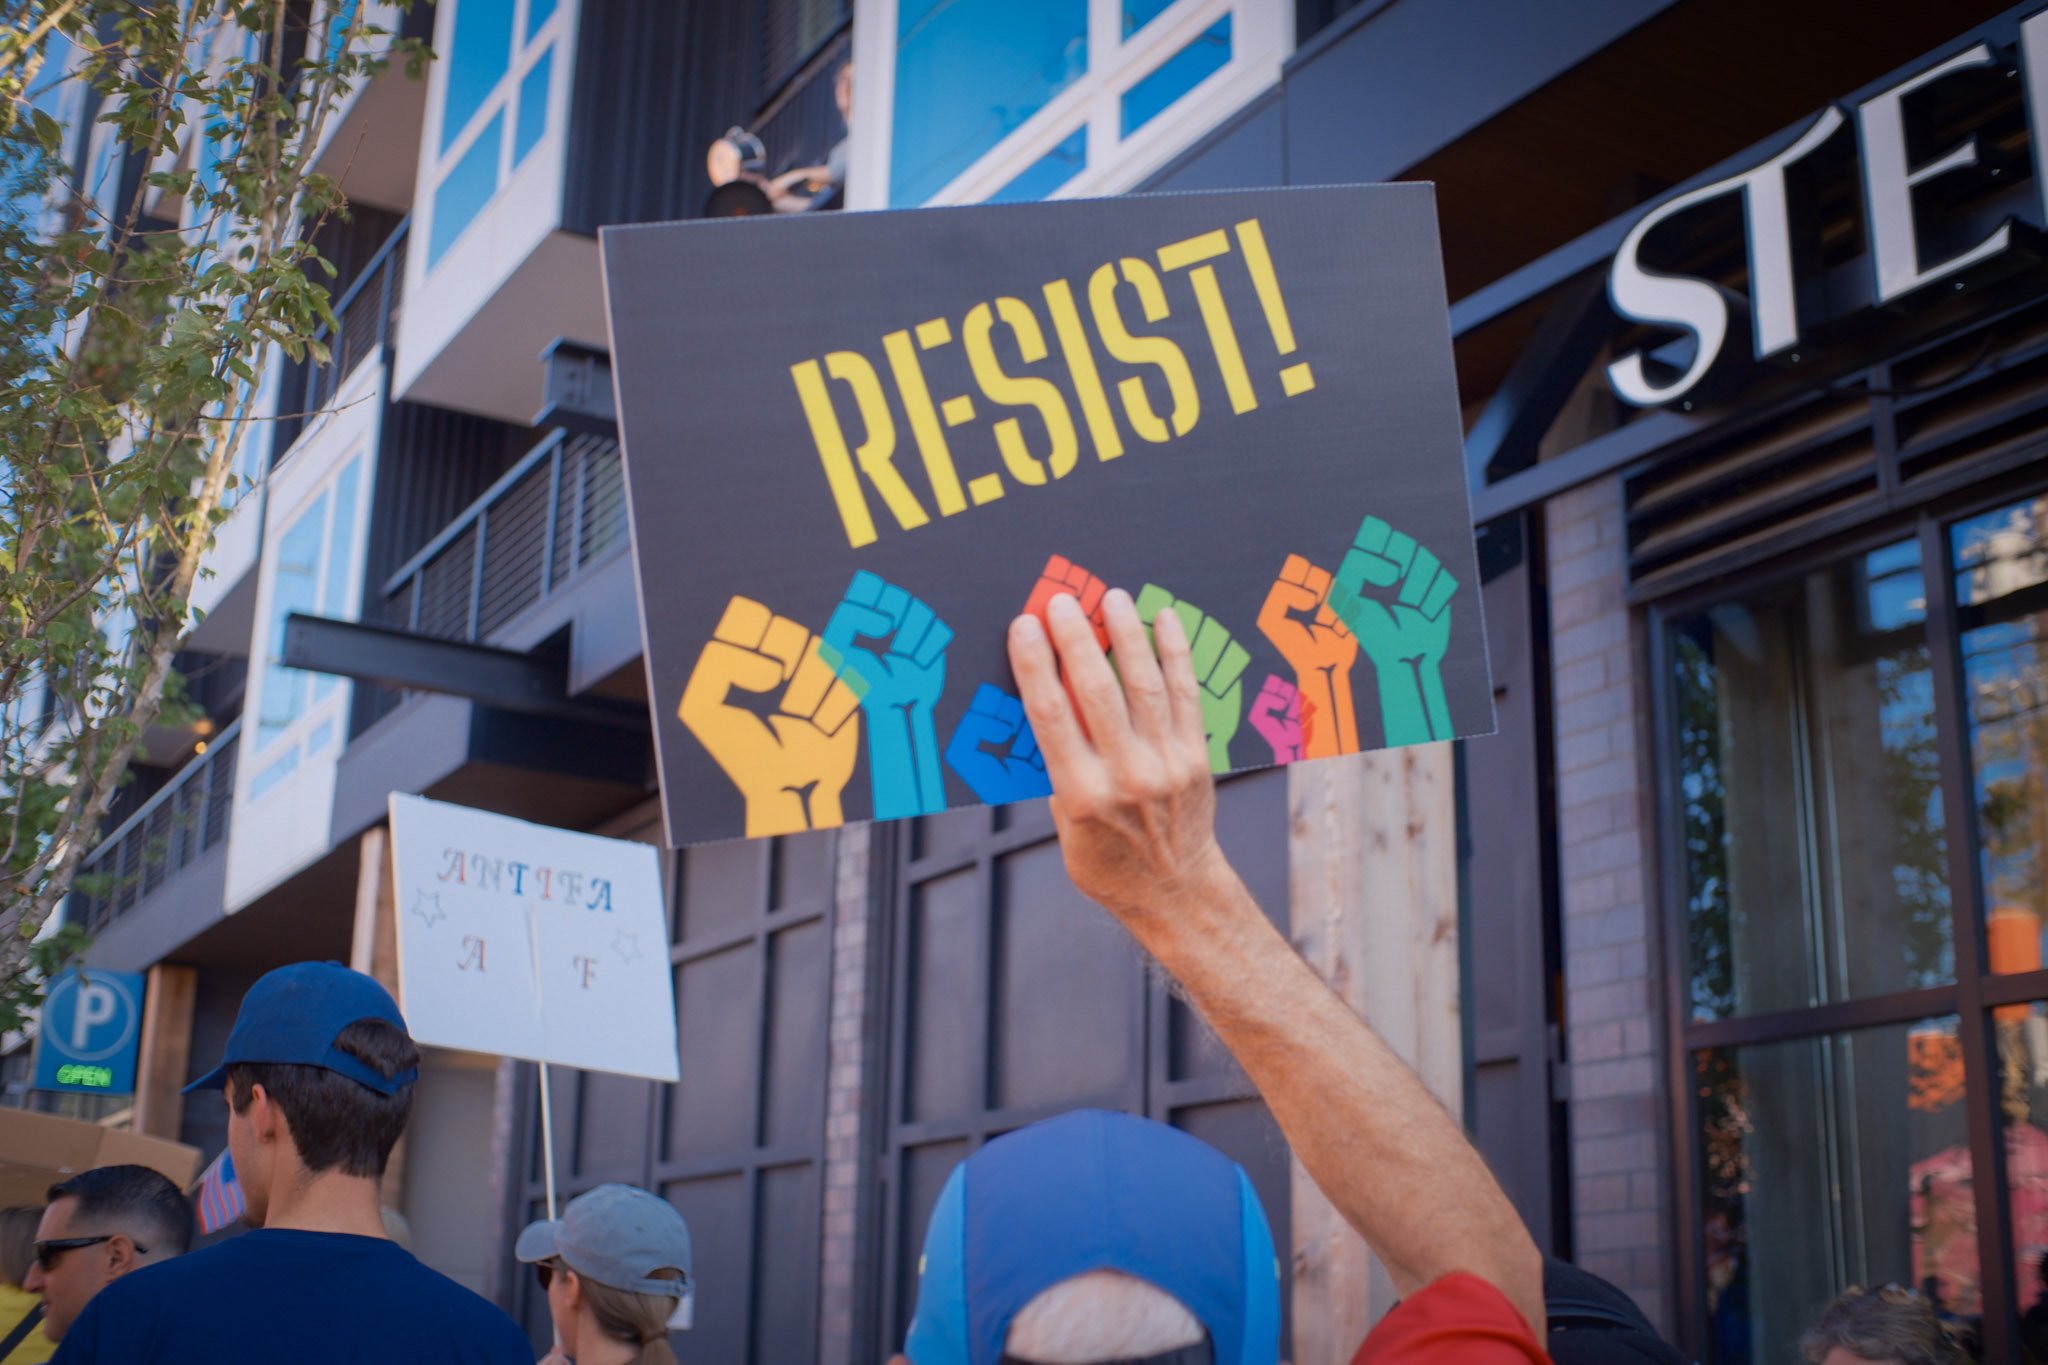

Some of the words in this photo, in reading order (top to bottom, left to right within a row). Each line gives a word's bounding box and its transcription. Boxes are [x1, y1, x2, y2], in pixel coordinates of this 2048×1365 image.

[790, 218, 1316, 549] RESIST!
[437, 846, 613, 912] ANTIFA
[457, 934, 487, 973] A
[572, 954, 599, 990] F
[72, 982, 117, 1050] P
[56, 1064, 112, 1088] OPEN
